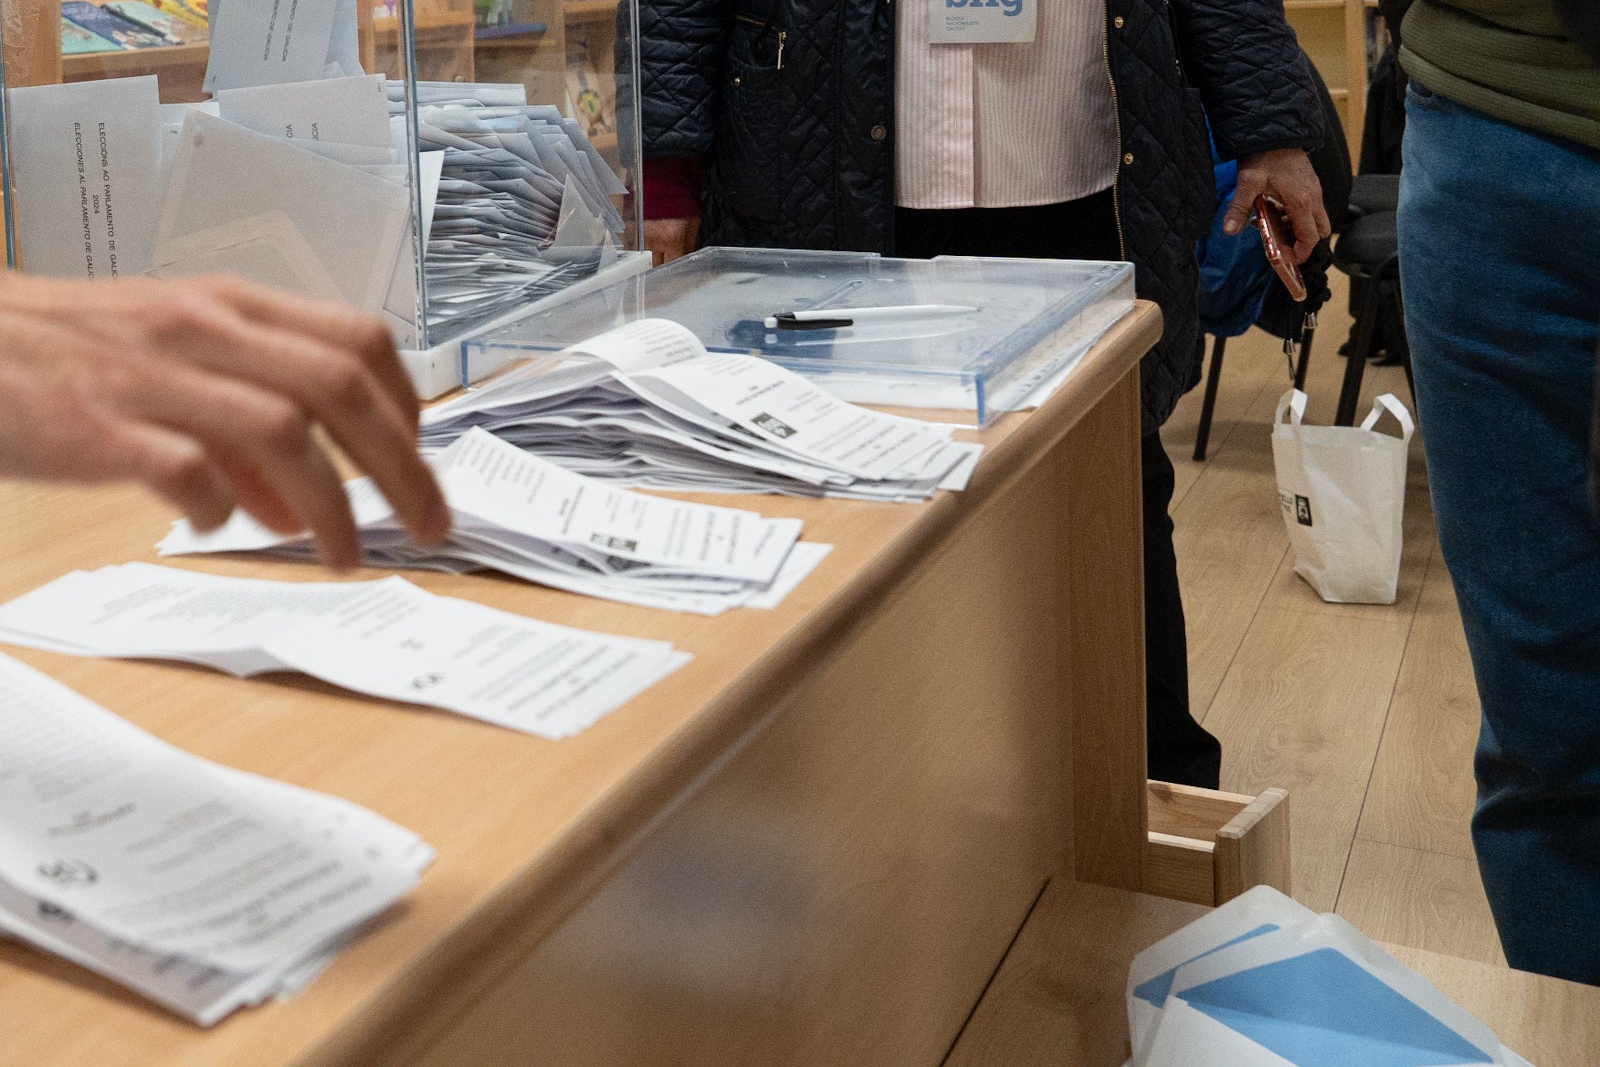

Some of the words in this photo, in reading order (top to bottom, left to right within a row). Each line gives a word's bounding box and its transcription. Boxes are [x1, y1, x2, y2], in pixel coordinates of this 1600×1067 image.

[74, 122, 85, 173] ELECCIONES
[79, 173, 86, 184] AL
[103, 169, 110, 182] AO
[80, 186, 91, 242] PARLAMENTO
[92, 194, 100, 214] 2024
[104, 184, 115, 238] PARLAMENTO
[84, 242, 92, 253] DE
[108, 240, 116, 251] DE
[86, 255, 95, 279] GALIC
[109, 254, 119, 277] GALIC
